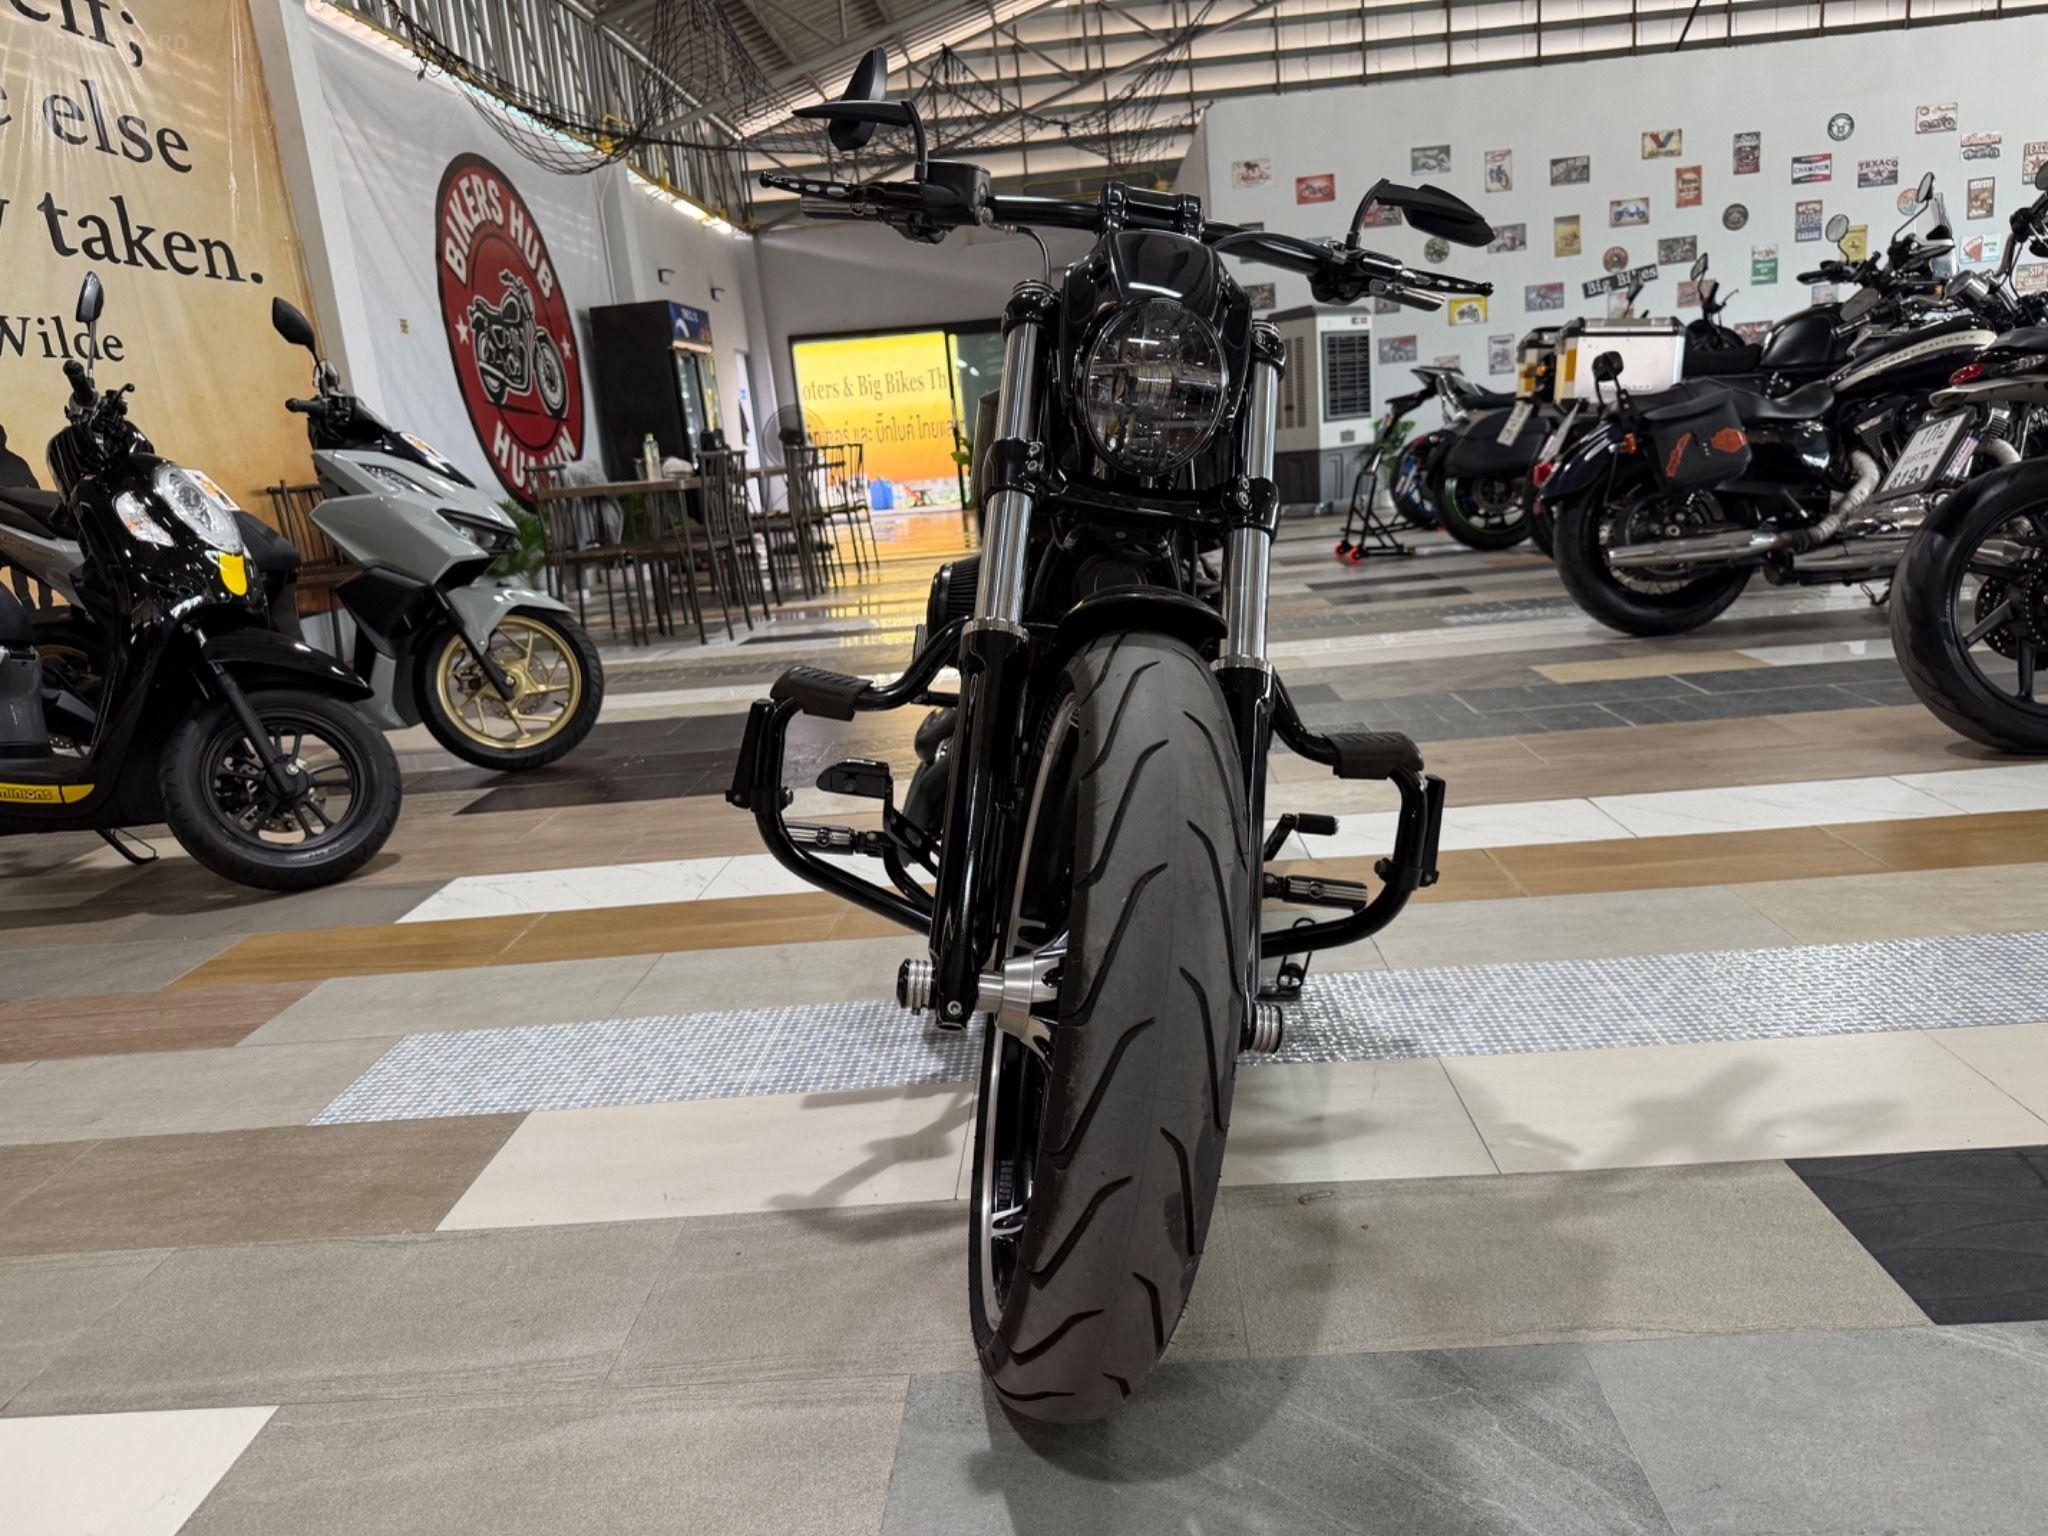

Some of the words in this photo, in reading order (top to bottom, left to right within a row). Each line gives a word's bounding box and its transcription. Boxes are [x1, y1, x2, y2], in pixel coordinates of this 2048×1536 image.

[42, 79, 193, 173] else
[1858, 159, 1899, 171] TEXACO
[37, 192, 264, 284] taken.
[445, 174, 504, 286] BIKERS
[509, 199, 554, 299] HUB
[1586, 279, 1611, 295] Big
[1617, 266, 1657, 286] Bies
[843, 375, 854, 398] &
[858, 372, 883, 401] Big
[885, 370, 925, 394] Bikes
